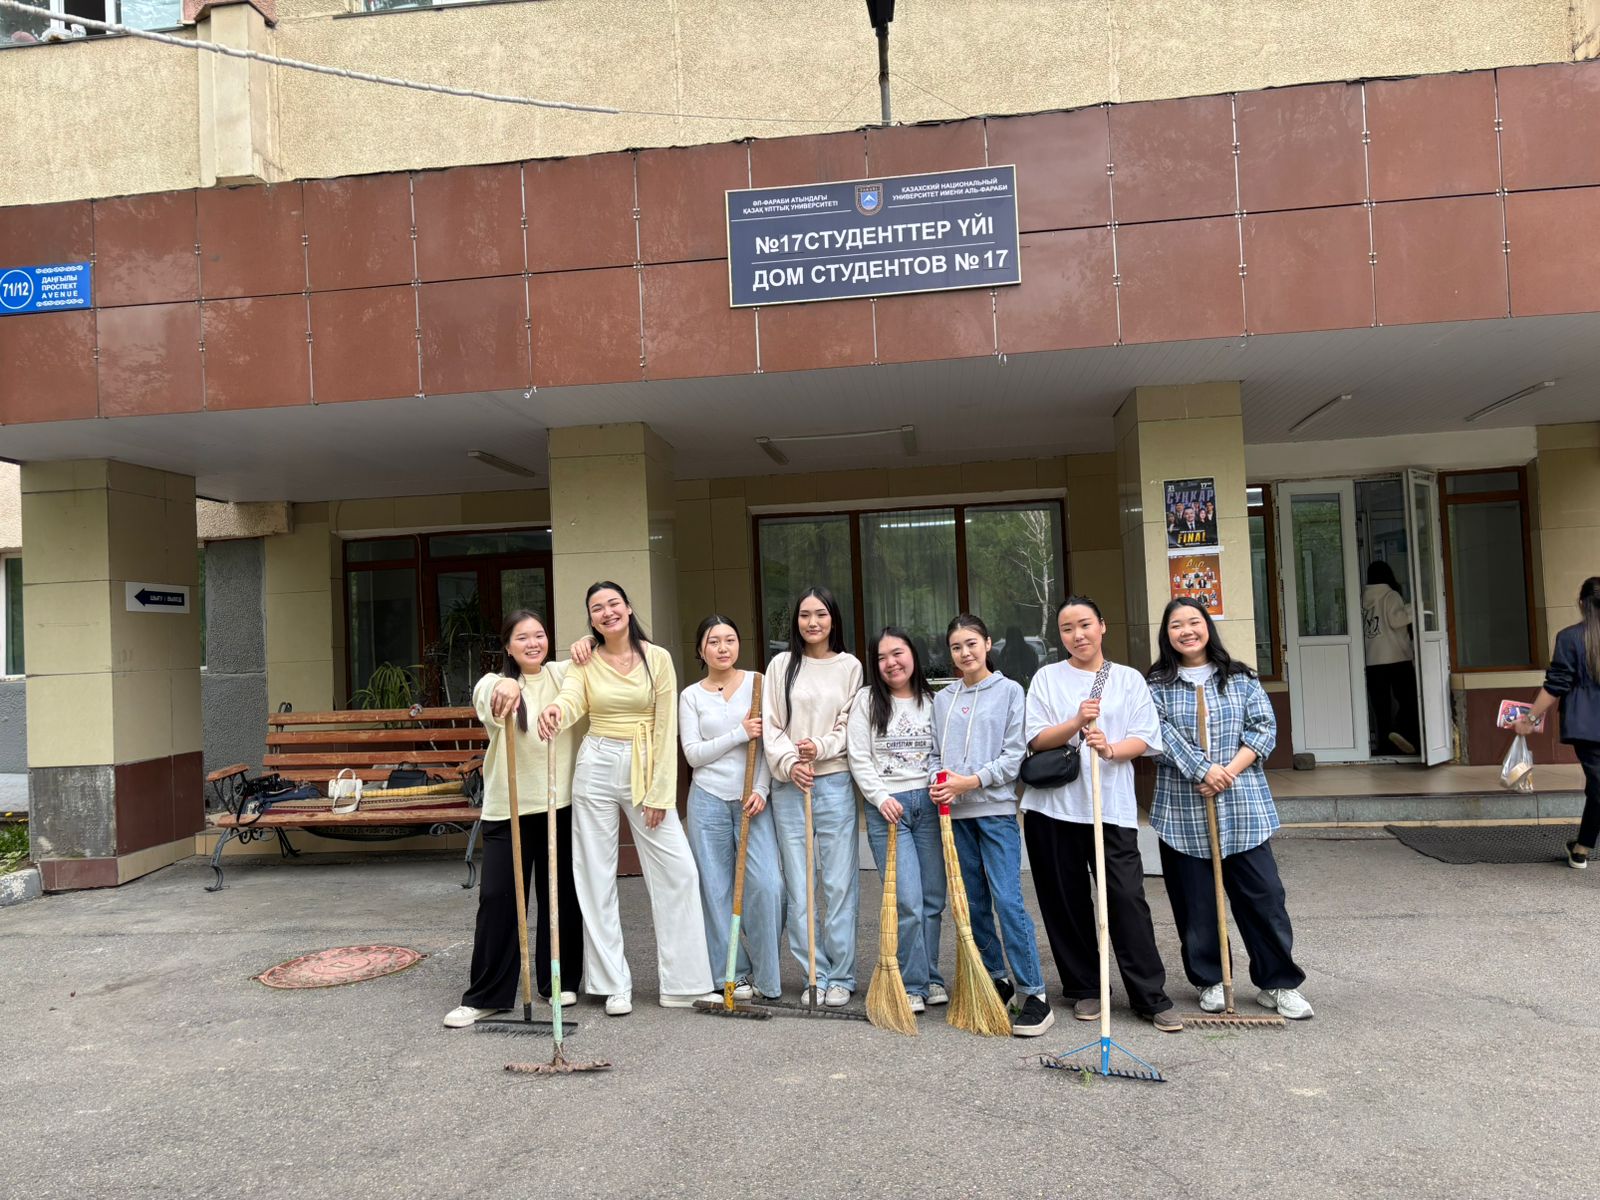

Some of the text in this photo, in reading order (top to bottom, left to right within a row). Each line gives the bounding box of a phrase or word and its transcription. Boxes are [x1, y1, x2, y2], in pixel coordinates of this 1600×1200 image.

[902, 177, 998, 193] КАЗАХСКИЙ НАЦИОНАЛЬНЫЙ
[791, 194, 828, 203] АТЫНДАҒЫ
[892, 191, 938, 201] УНИВЕРСИТЕТ
[965, 185, 1008, 195] АЛЬ-ФАРАБИ
[743, 205, 763, 215] ҚАЗАҚ
[791, 200, 838, 210] УНИВЕРСИТЕТІ
[957, 211, 994, 236] ҮЙІ
[752, 249, 1009, 292] ДОМ СТУДЕНТОВ № 17
[41, 275, 77, 284] ДАҢҒЫЛЫ
[2, 281, 29, 298] 71/12
[41, 290, 79, 299] AVENUE
[1177, 531, 1207, 544] FINAL
